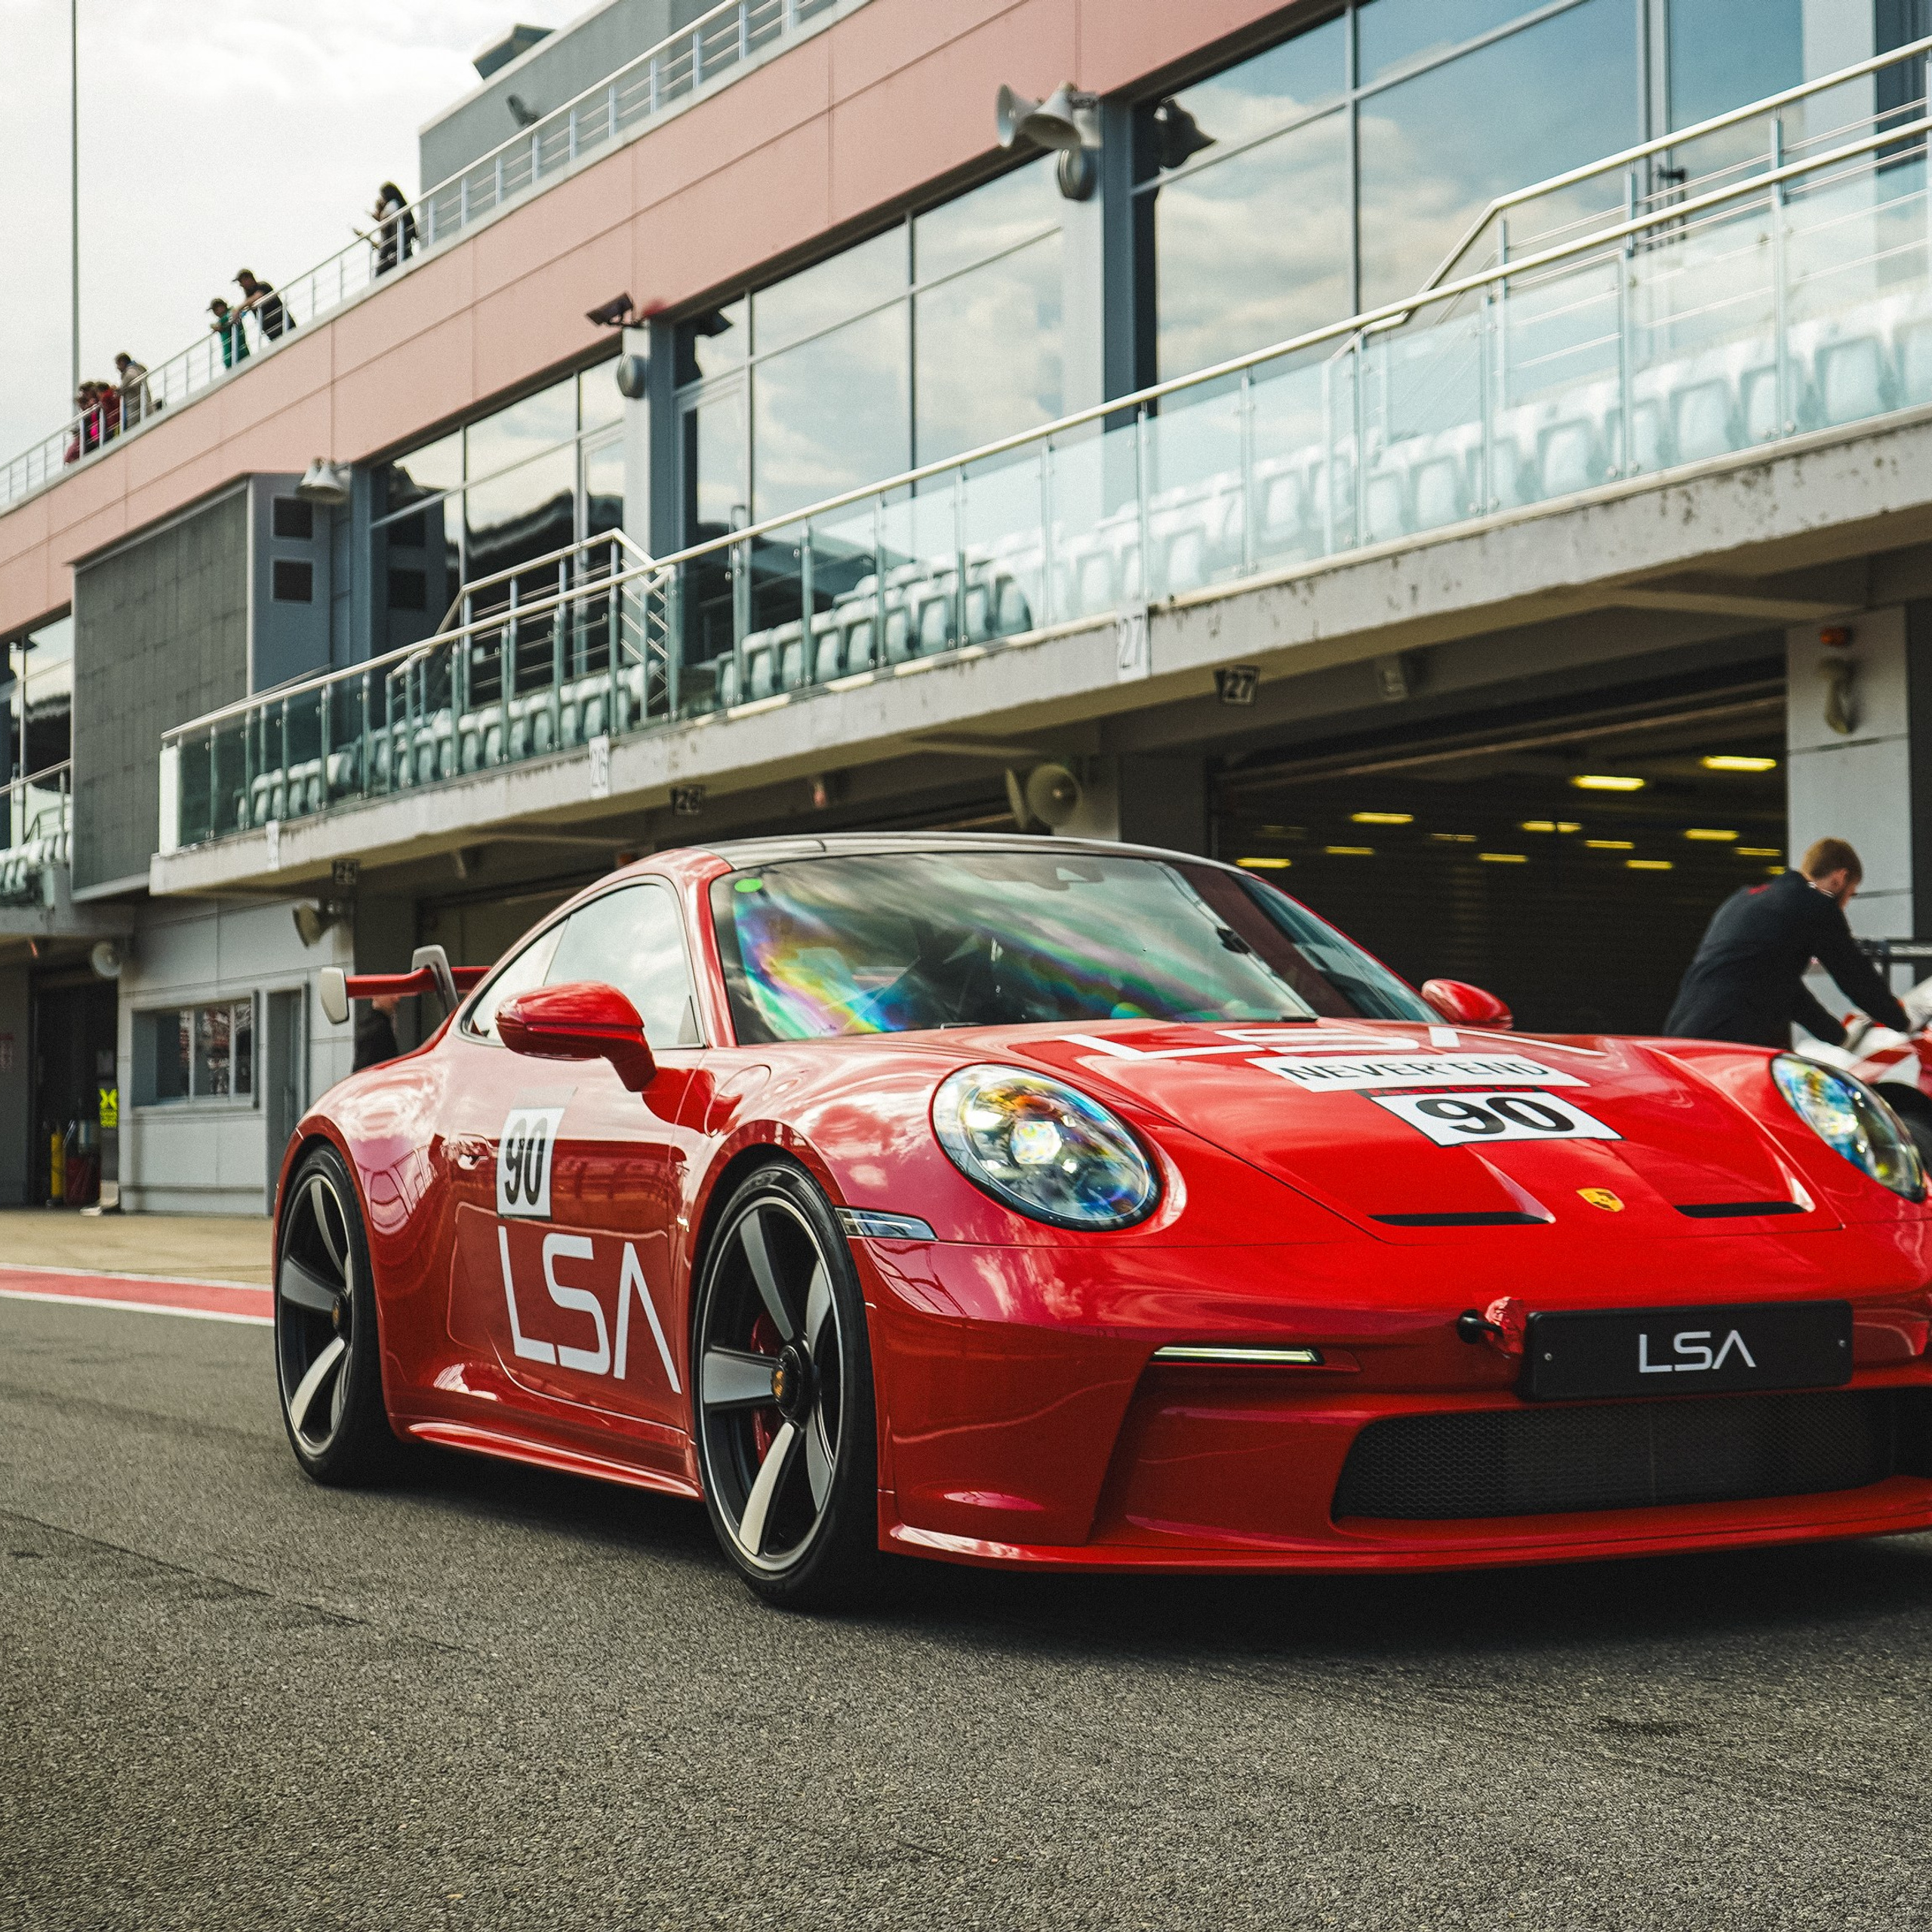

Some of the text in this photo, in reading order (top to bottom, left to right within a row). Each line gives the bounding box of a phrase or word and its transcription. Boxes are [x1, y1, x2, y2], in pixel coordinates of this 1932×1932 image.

[1118, 614, 1144, 669] 27
[1225, 672, 1254, 700] 27
[591, 746, 609, 787] 26
[1416, 1097, 1575, 1135] 90
[504, 1117, 548, 1205] 90
[497, 1226, 682, 1395] LSA
[1639, 1329, 1757, 1374] LSA
